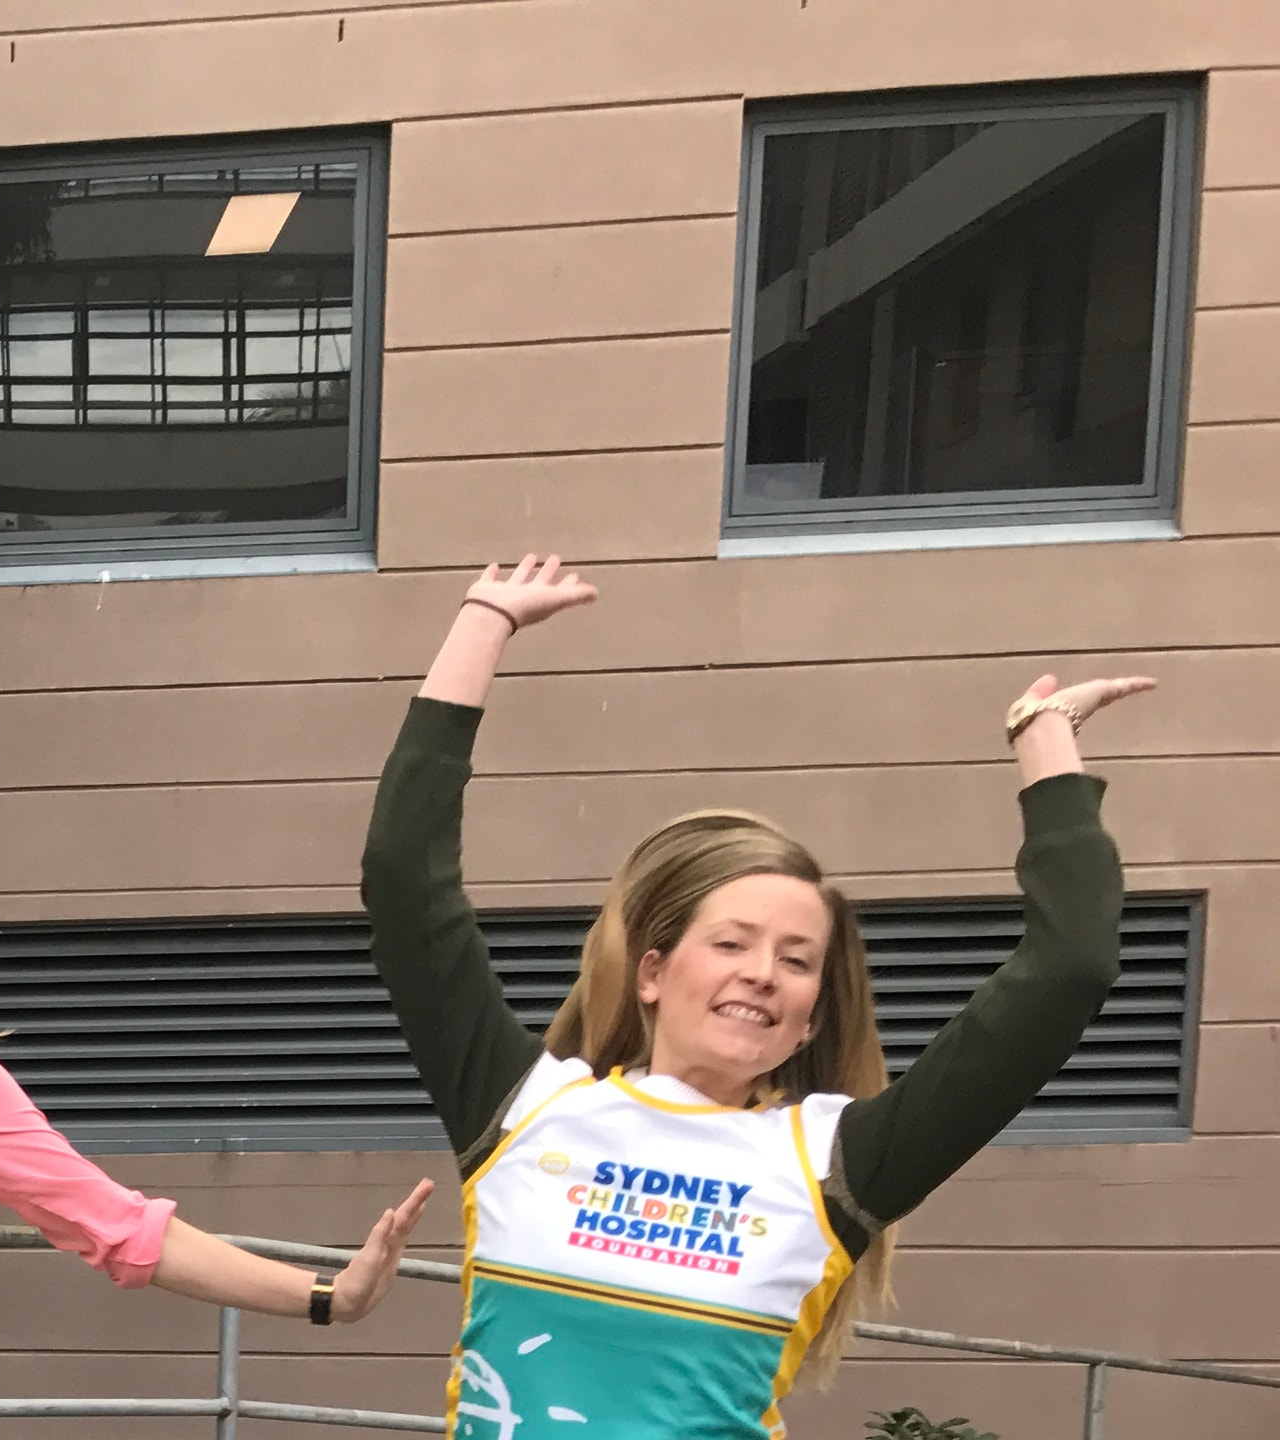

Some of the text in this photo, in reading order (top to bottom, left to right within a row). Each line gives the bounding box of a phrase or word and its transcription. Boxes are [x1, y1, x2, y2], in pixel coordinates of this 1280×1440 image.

[593, 1161, 753, 1208] SYDNEY
[566, 1184, 768, 1237] CHILDREN'S
[574, 1209, 744, 1258] HOSPITAL
[576, 1235, 730, 1273] FOUNDATION
